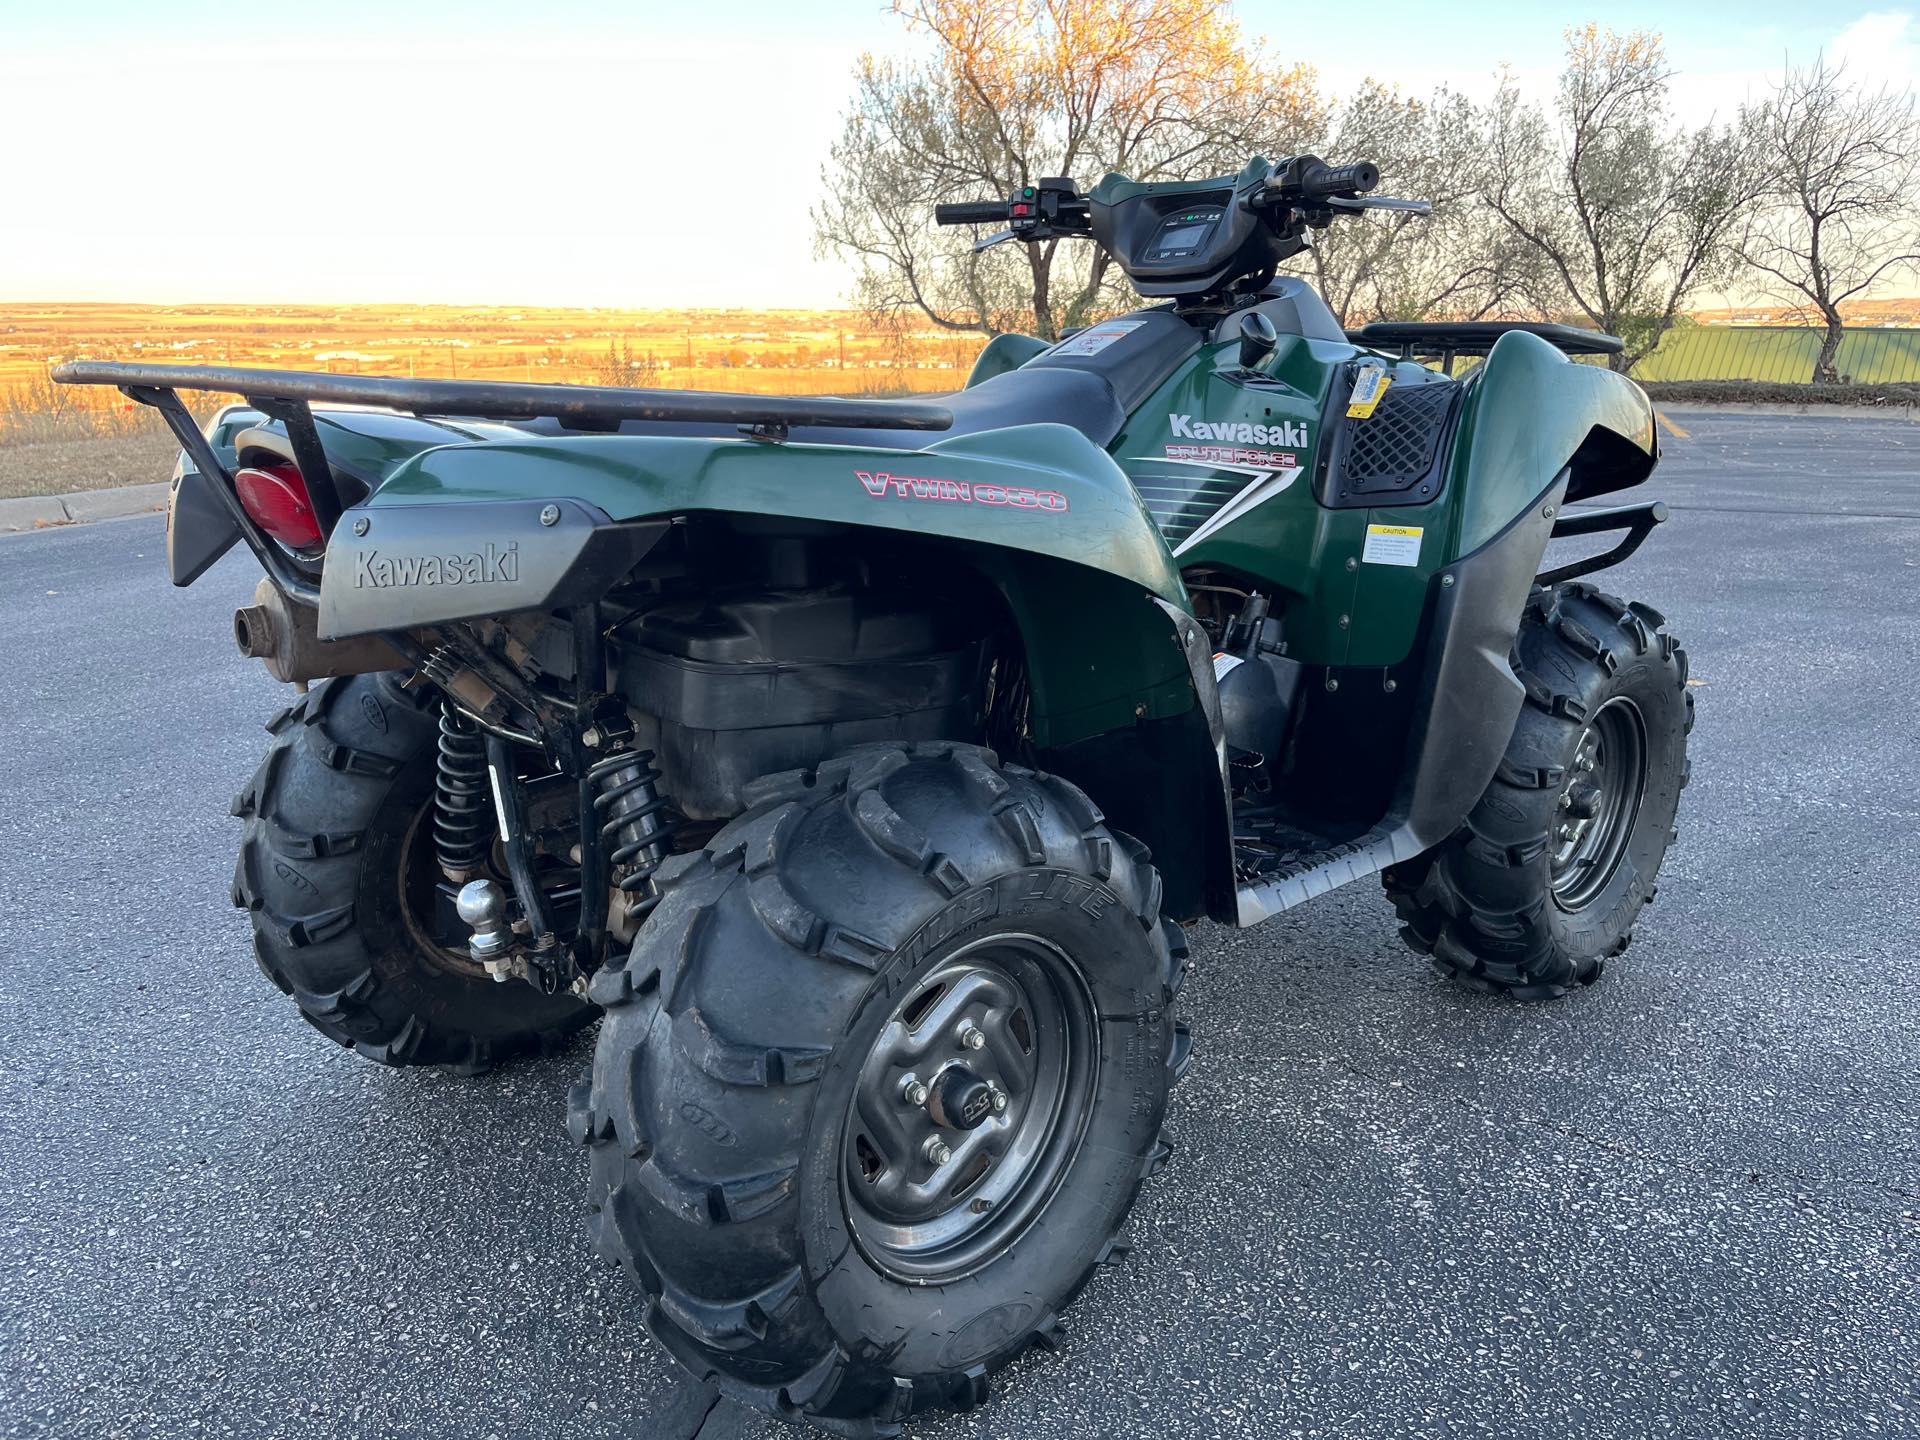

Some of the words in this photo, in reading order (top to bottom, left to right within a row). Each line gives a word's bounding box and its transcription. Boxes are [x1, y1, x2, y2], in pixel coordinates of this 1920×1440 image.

[1169, 413, 1308, 448] Kawasaki
[973, 483, 1069, 512] 650
[353, 541, 519, 588] Kawasaki
[1018, 873, 1116, 920] LITE
